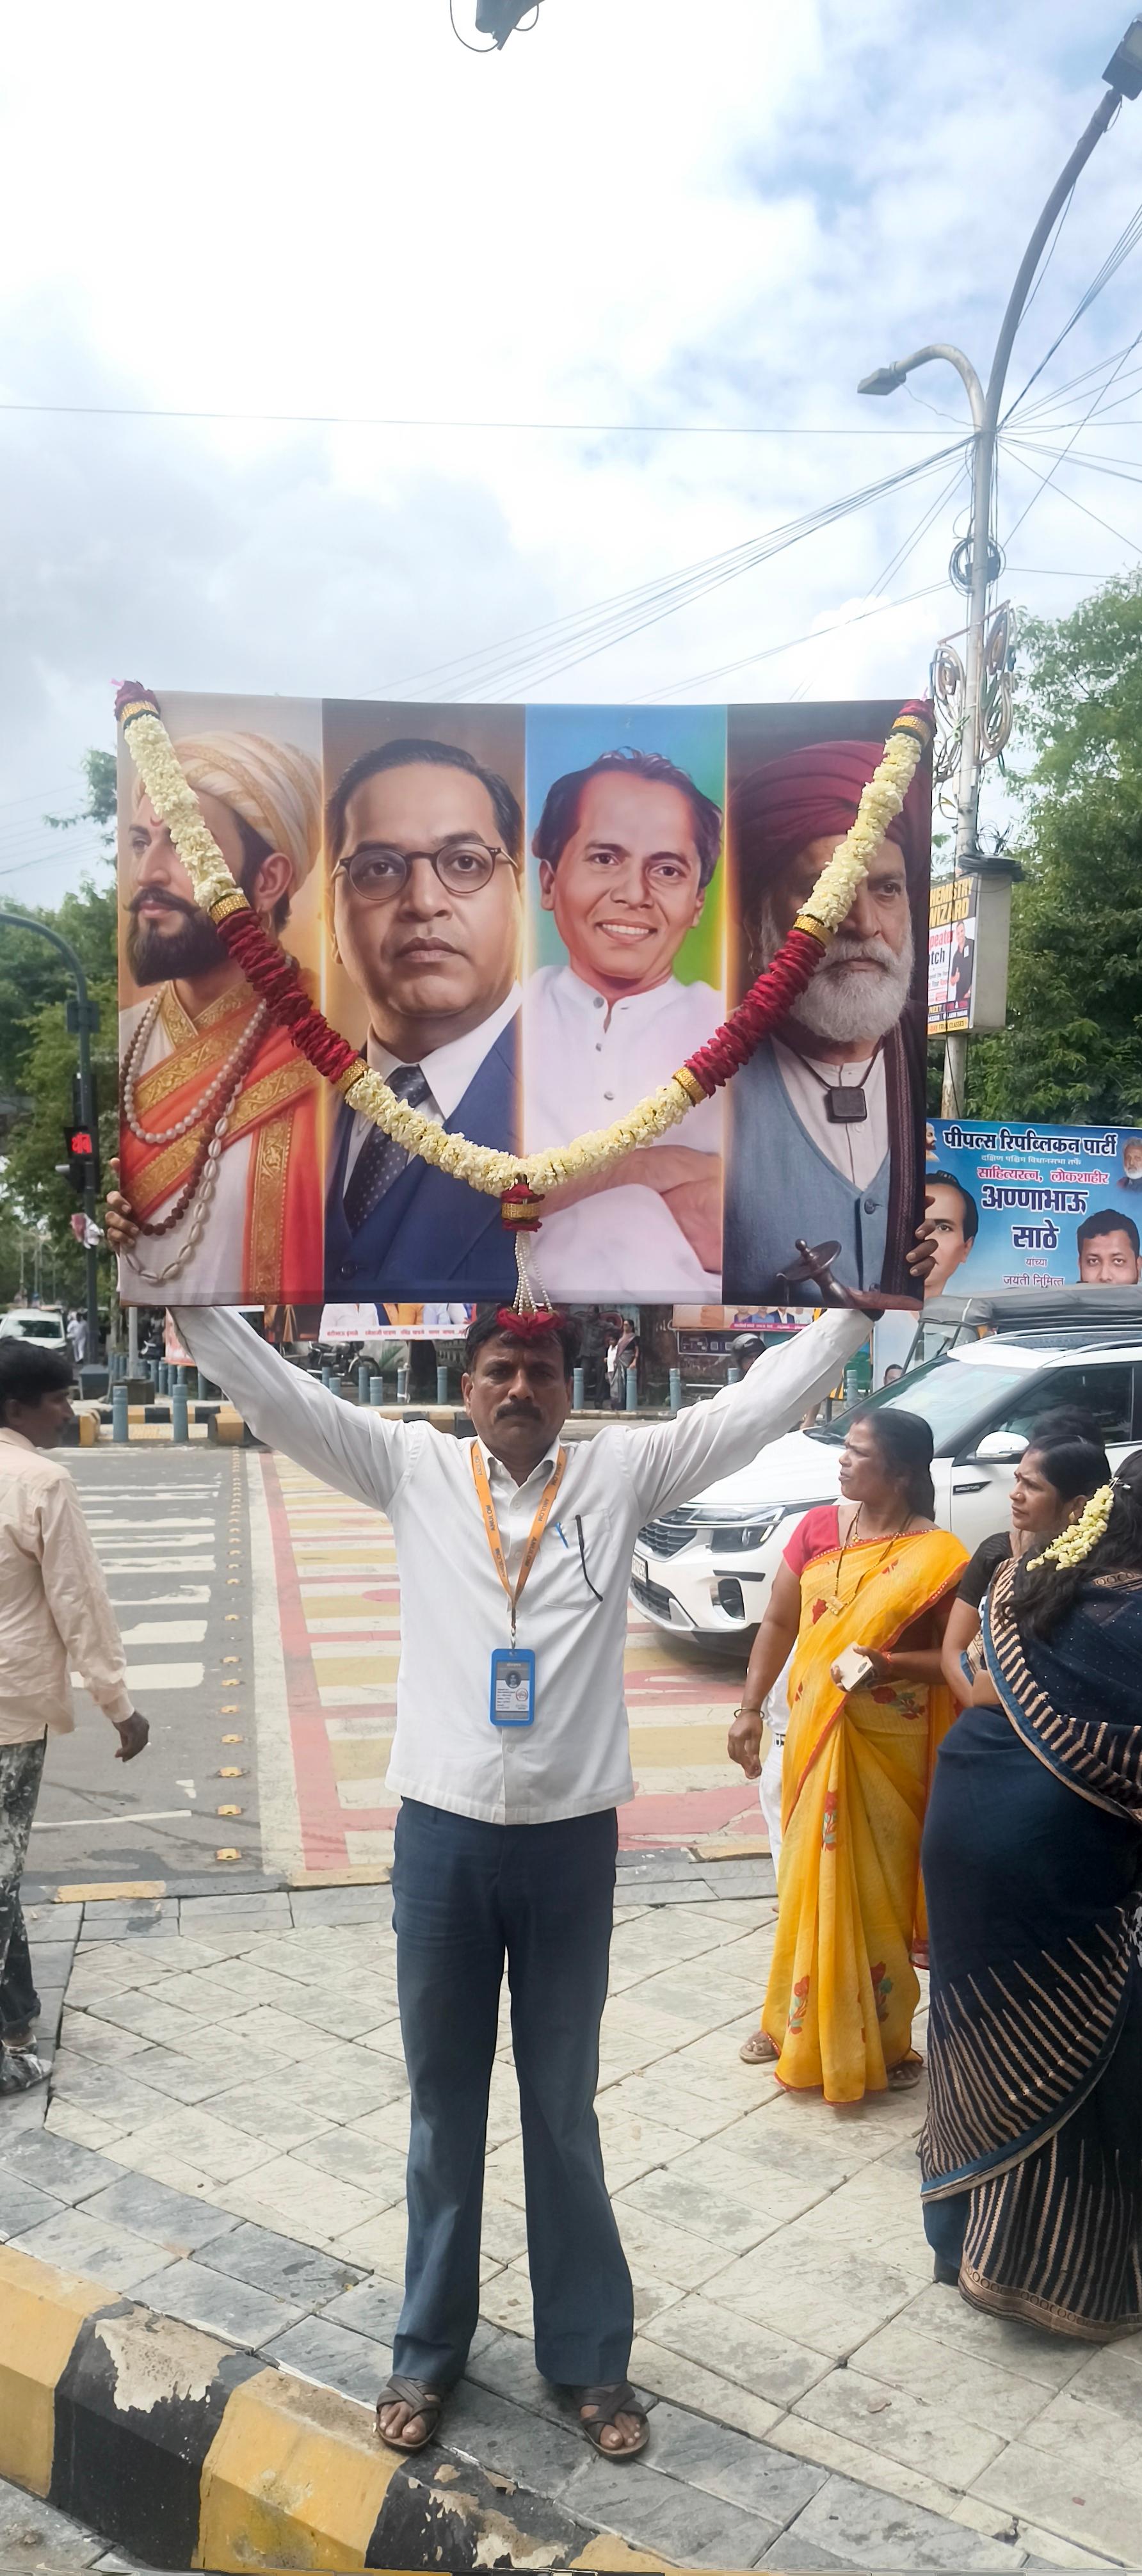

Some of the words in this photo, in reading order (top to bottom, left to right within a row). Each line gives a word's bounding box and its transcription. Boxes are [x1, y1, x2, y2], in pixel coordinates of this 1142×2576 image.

[930, 877, 974, 906] HEMISTRY
[929, 930, 954, 950] peater
[930, 948, 945, 965] tch
[944, 1125, 997, 1148] पीपल्स
[1000, 1127, 1080, 1153] रिपब्लिकन
[1083, 1133, 1118, 1155] पार्टी
[1050, 1168, 1109, 1184] लोकशाहीर
[981, 1185, 1088, 1214] अण्णाभाऊ
[1011, 1218, 1060, 1250] साठे
[1025, 1257, 1047, 1267] यांच्या
[1003, 1273, 1029, 1285] जयंती
[551, 1461, 562, 1485] ANULOM
[486, 1505, 495, 1531] ANULOM
[538, 1498, 549, 1522] ANULOM
[525, 1536, 537, 1567] ANULOM
